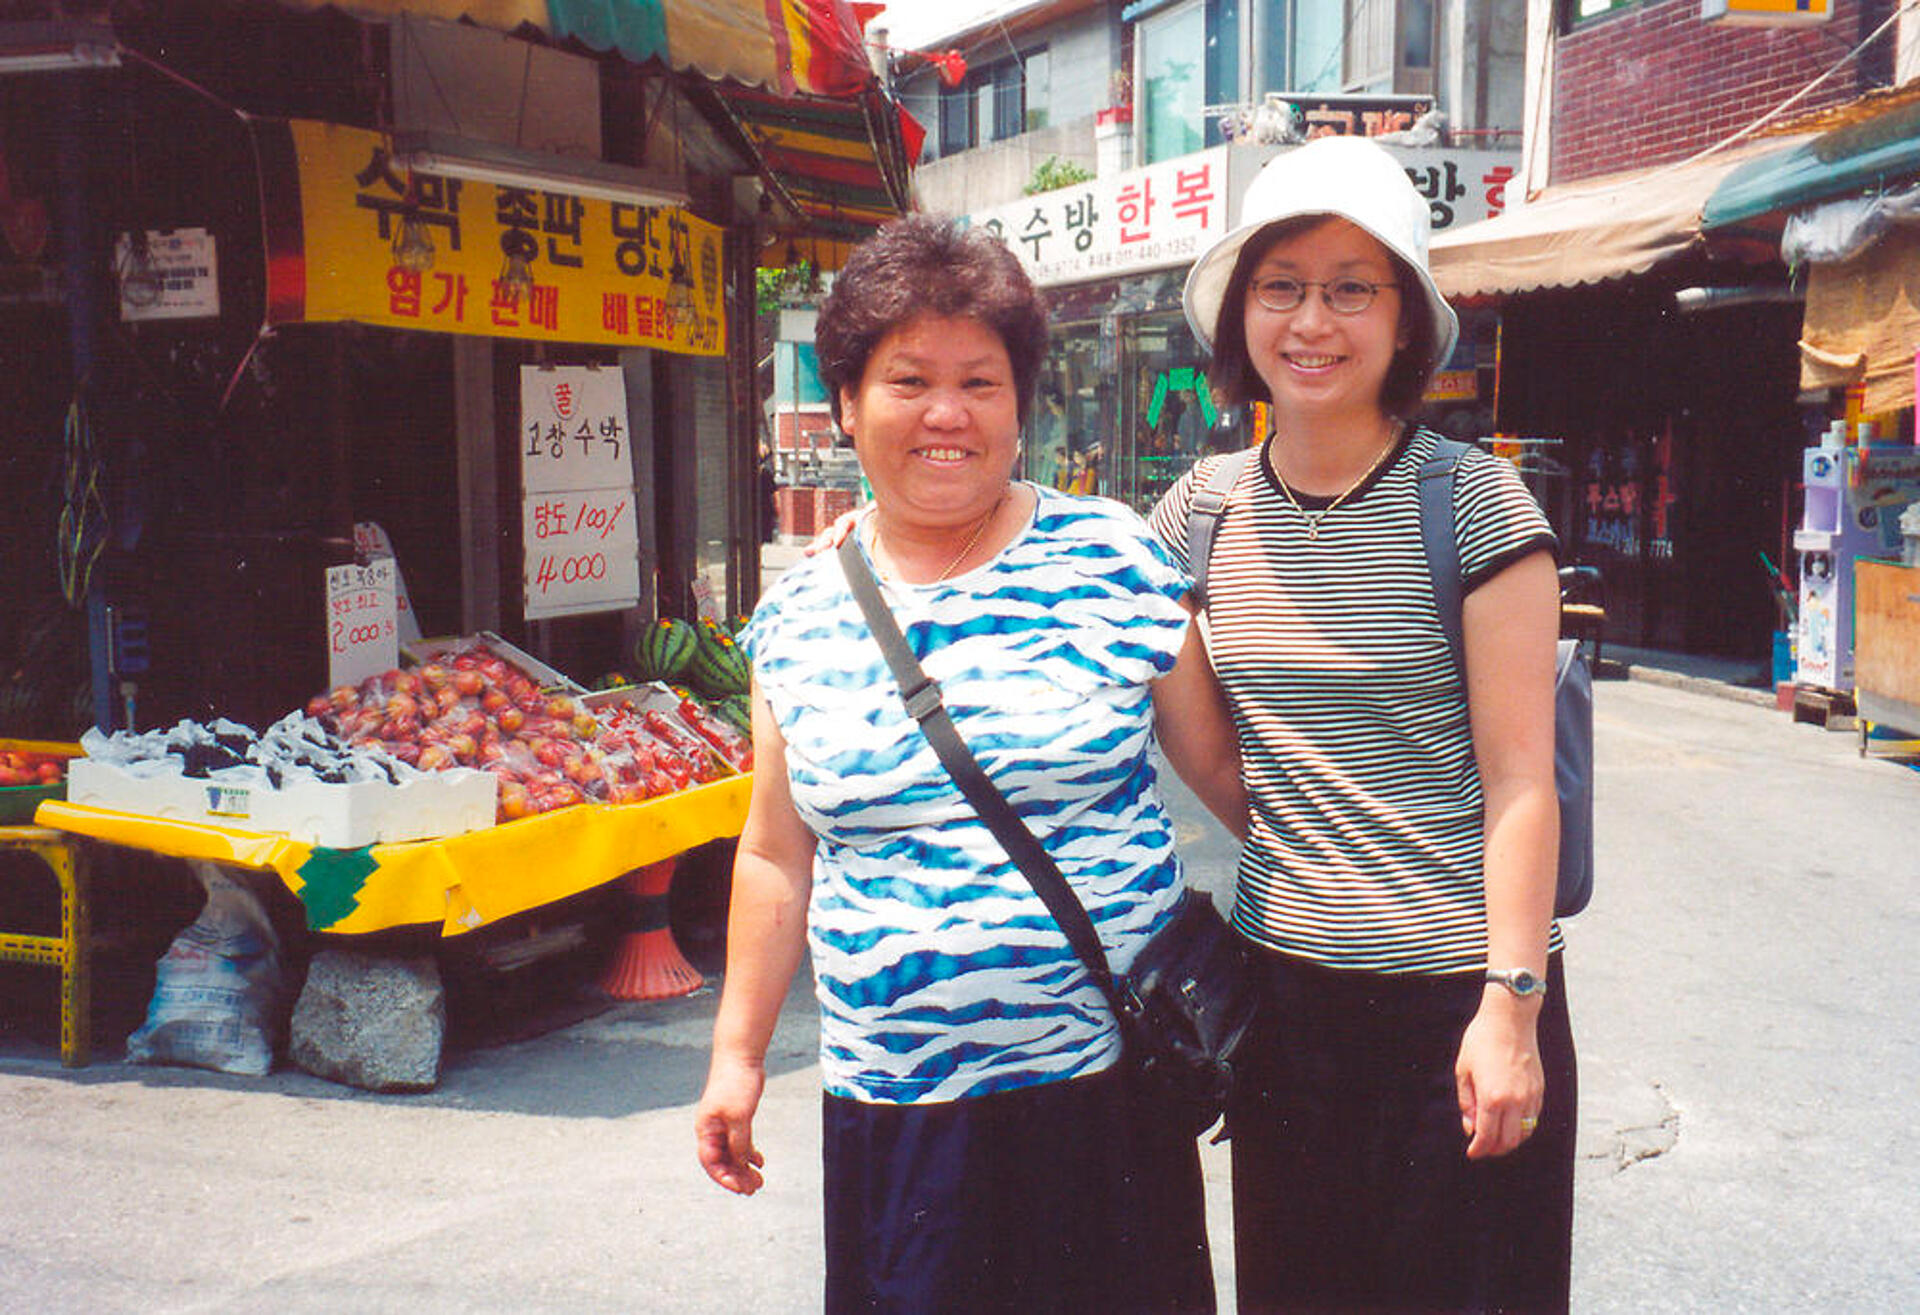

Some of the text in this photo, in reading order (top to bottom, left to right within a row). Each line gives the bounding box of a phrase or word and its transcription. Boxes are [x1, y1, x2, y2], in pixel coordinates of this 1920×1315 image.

[1115, 164, 1215, 245] 한복
[574, 415, 623, 461] 수박
[534, 502, 626, 539] 당도 100%
